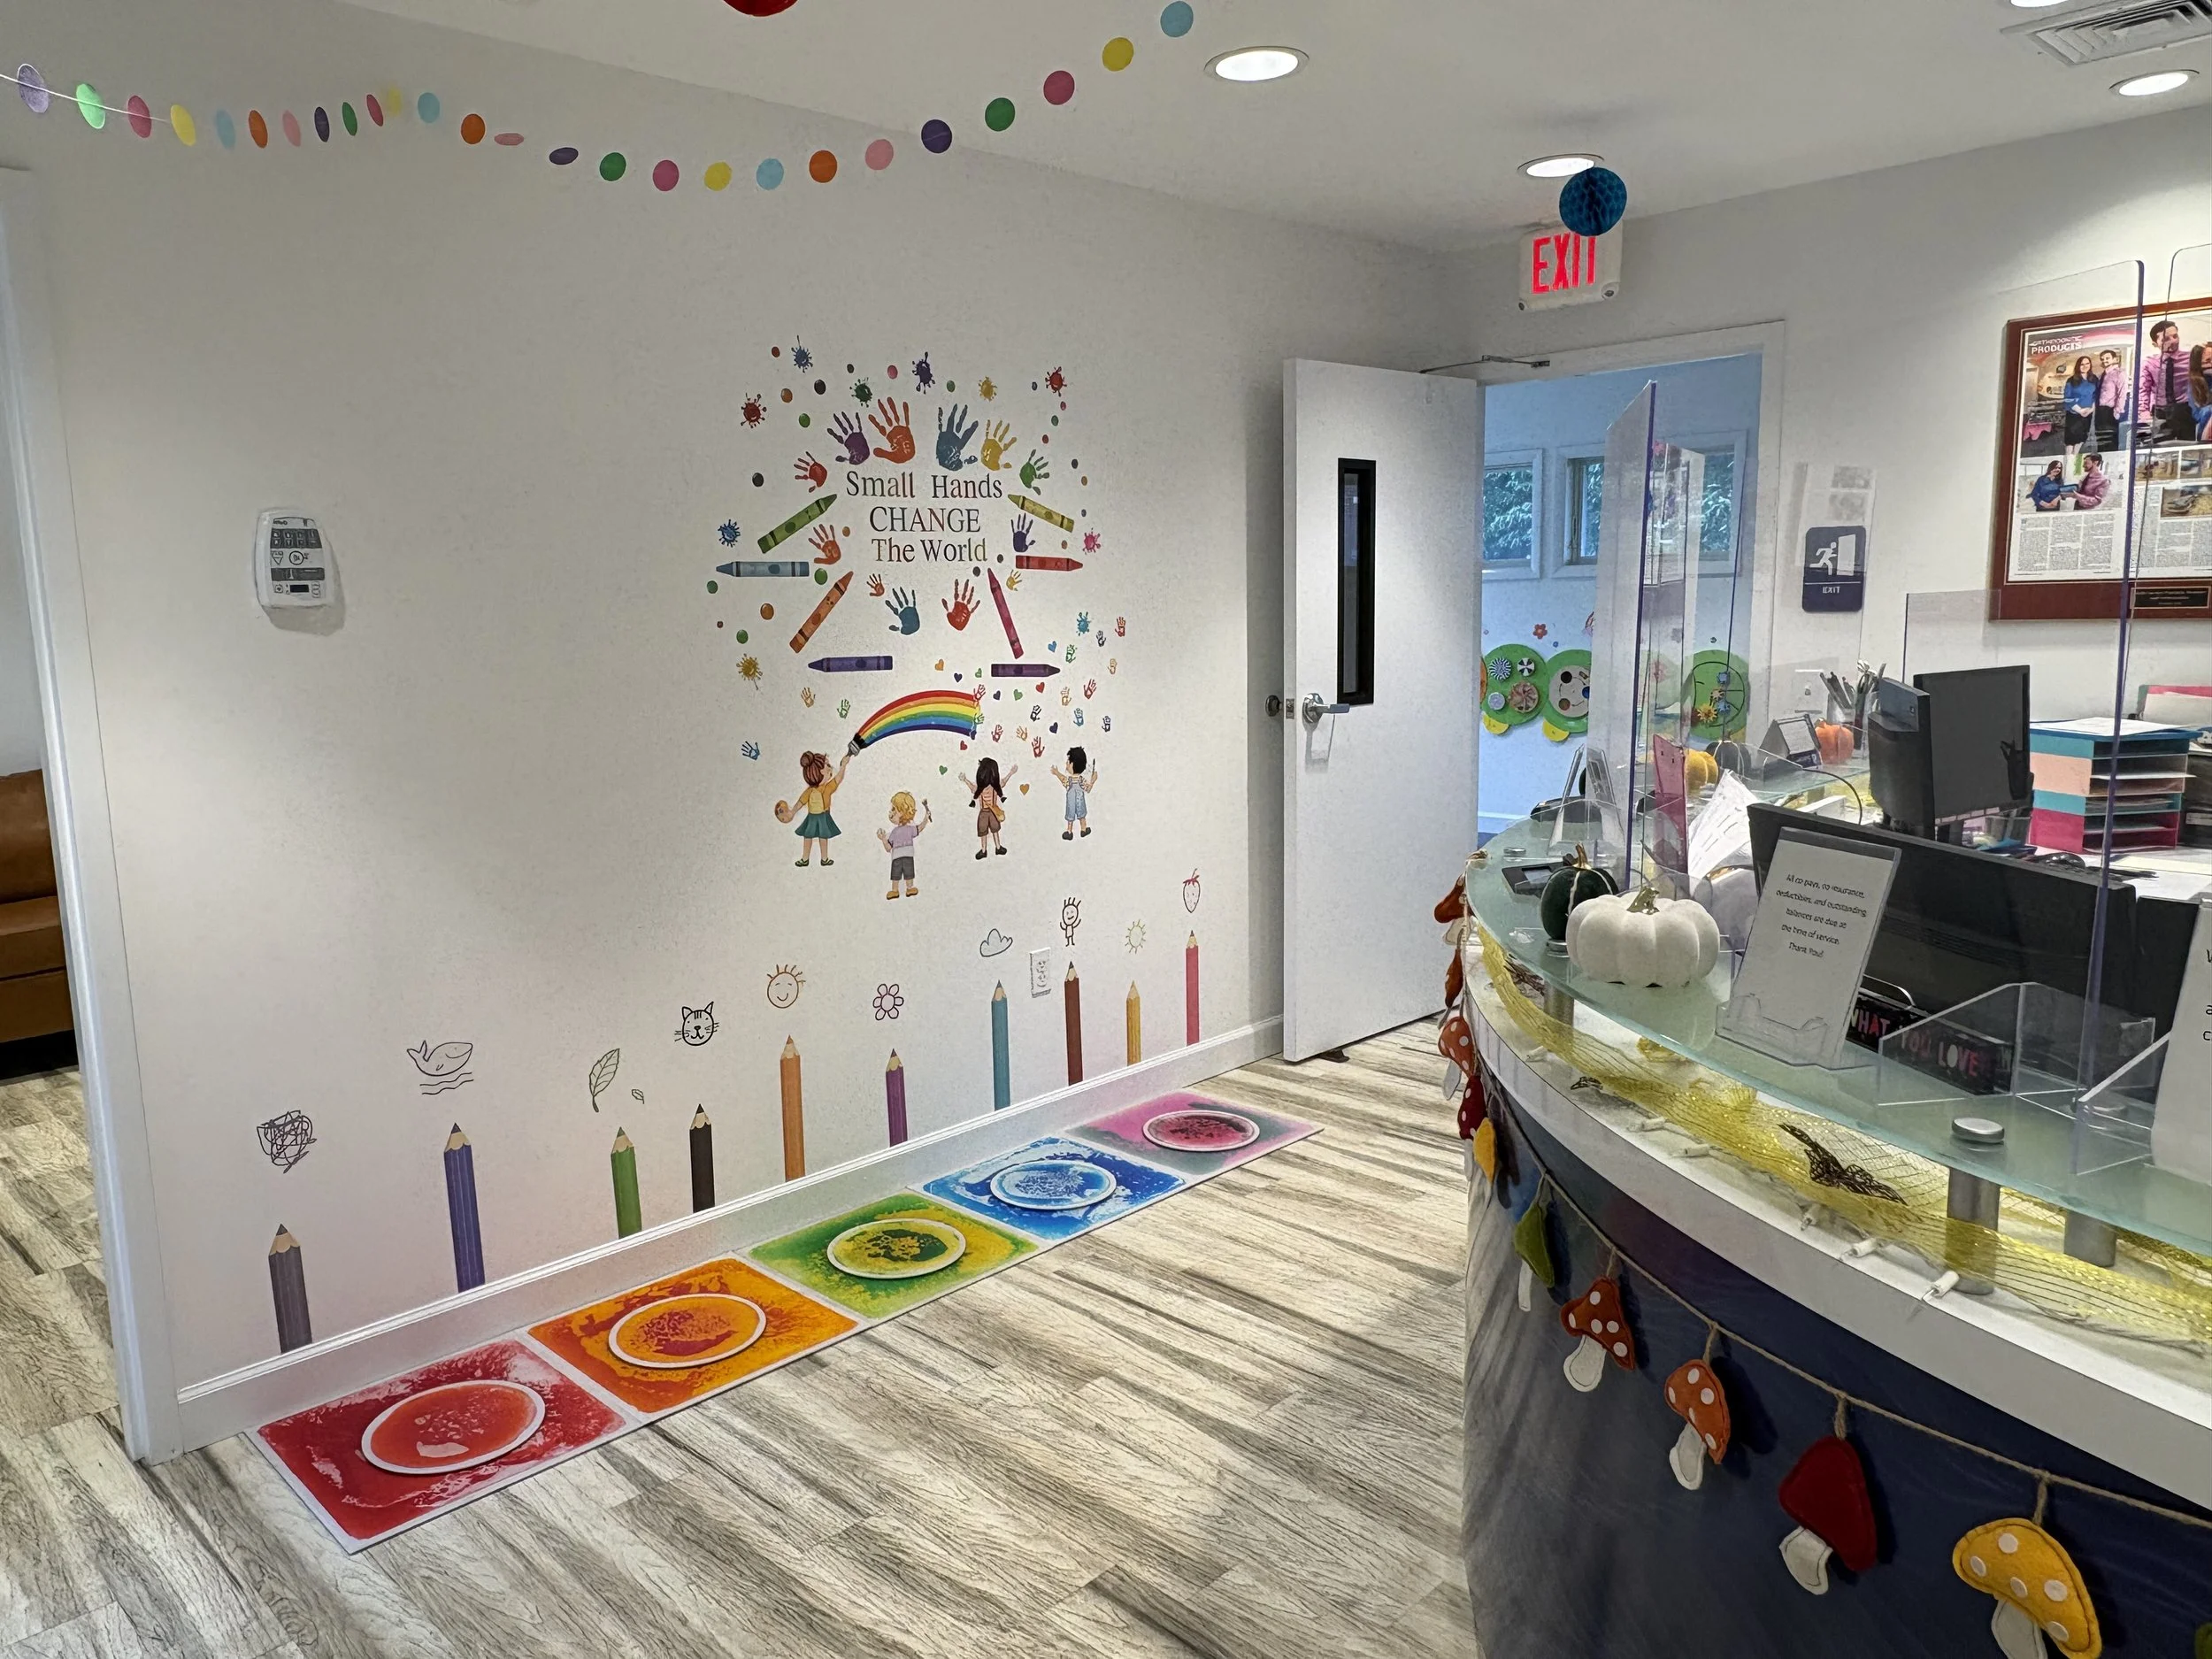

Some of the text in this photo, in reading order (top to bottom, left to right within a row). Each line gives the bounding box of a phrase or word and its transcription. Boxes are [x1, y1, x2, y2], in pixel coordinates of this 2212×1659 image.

[2031, 341, 2083, 355] PRODUCTS
[846, 470, 1002, 499] Small Hands
[870, 506, 981, 533] CHANGE
[872, 536, 988, 563] The World
[1822, 585, 1840, 594] EXIT
[1938, 1041, 1978, 1077] LOVE
